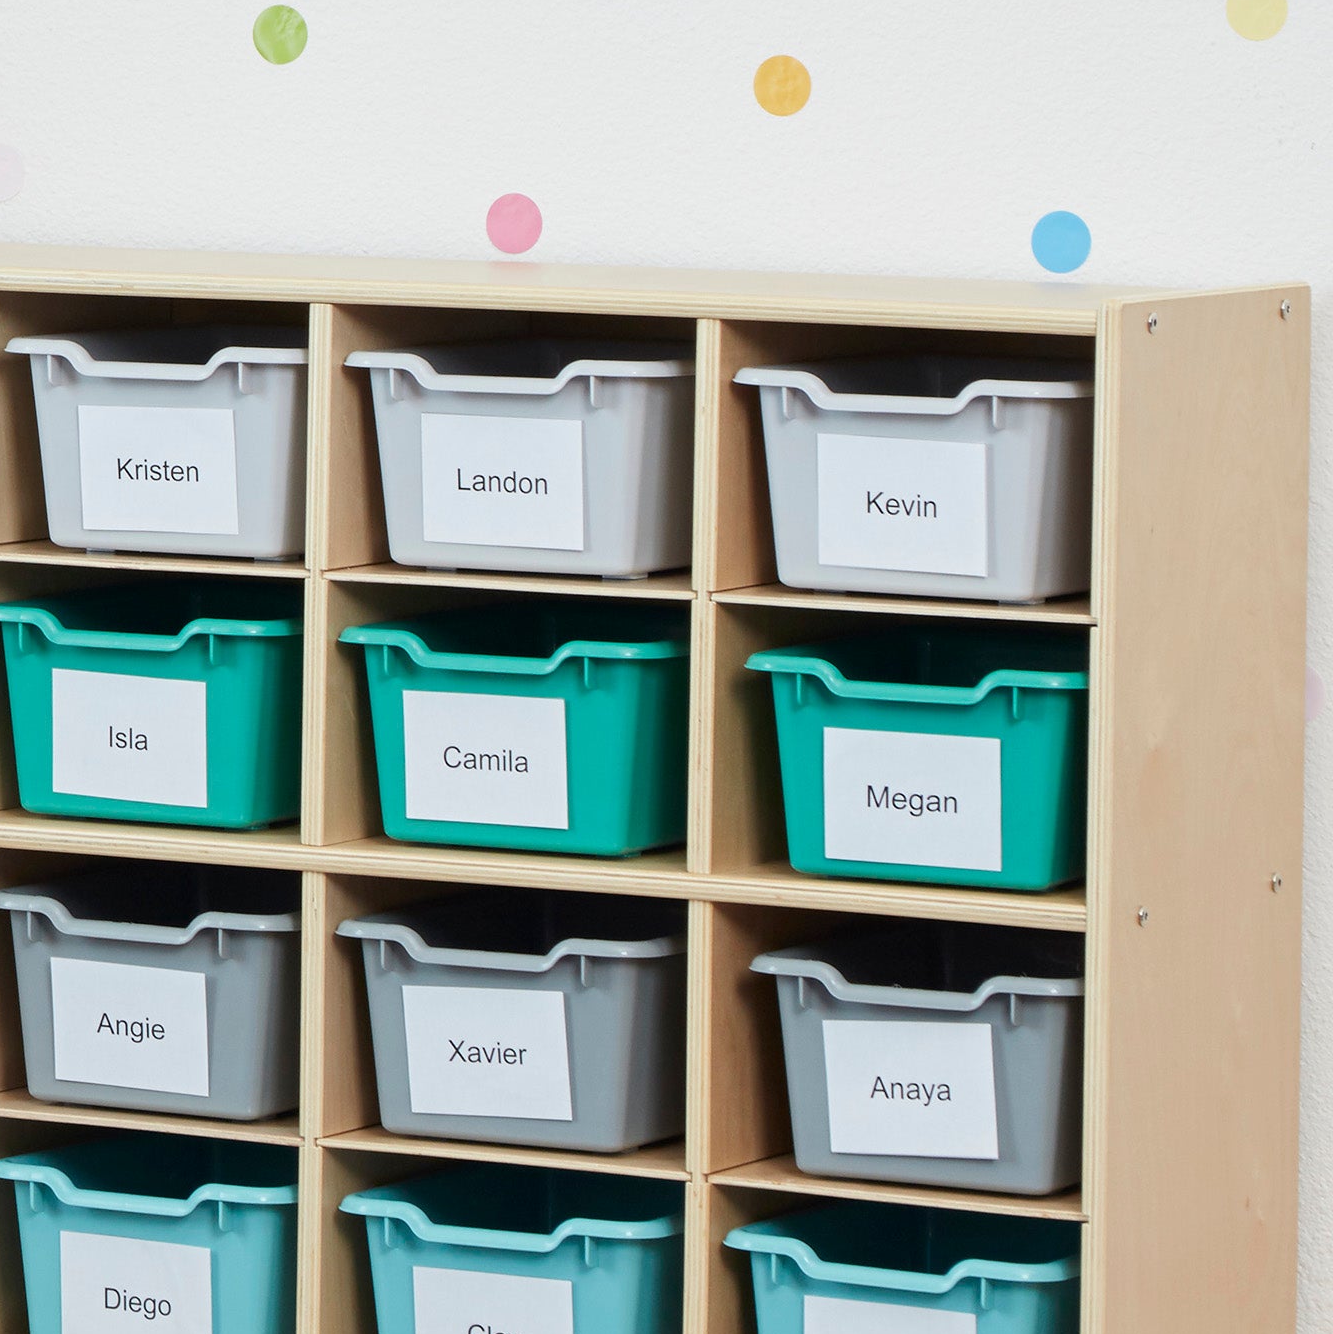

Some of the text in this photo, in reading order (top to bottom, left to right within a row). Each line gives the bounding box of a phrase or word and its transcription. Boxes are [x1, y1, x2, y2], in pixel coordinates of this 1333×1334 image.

[116, 457, 199, 483] Kristen
[457, 467, 548, 495] Landon
[866, 490, 937, 519] Kevin
[109, 725, 148, 751] Isla
[443, 745, 529, 773] Camila
[867, 784, 958, 818] Megan
[96, 1012, 166, 1044] Angie
[448, 1039, 528, 1065] Xavier
[870, 1075, 952, 1107] Anaya
[104, 1287, 172, 1321] Diego
